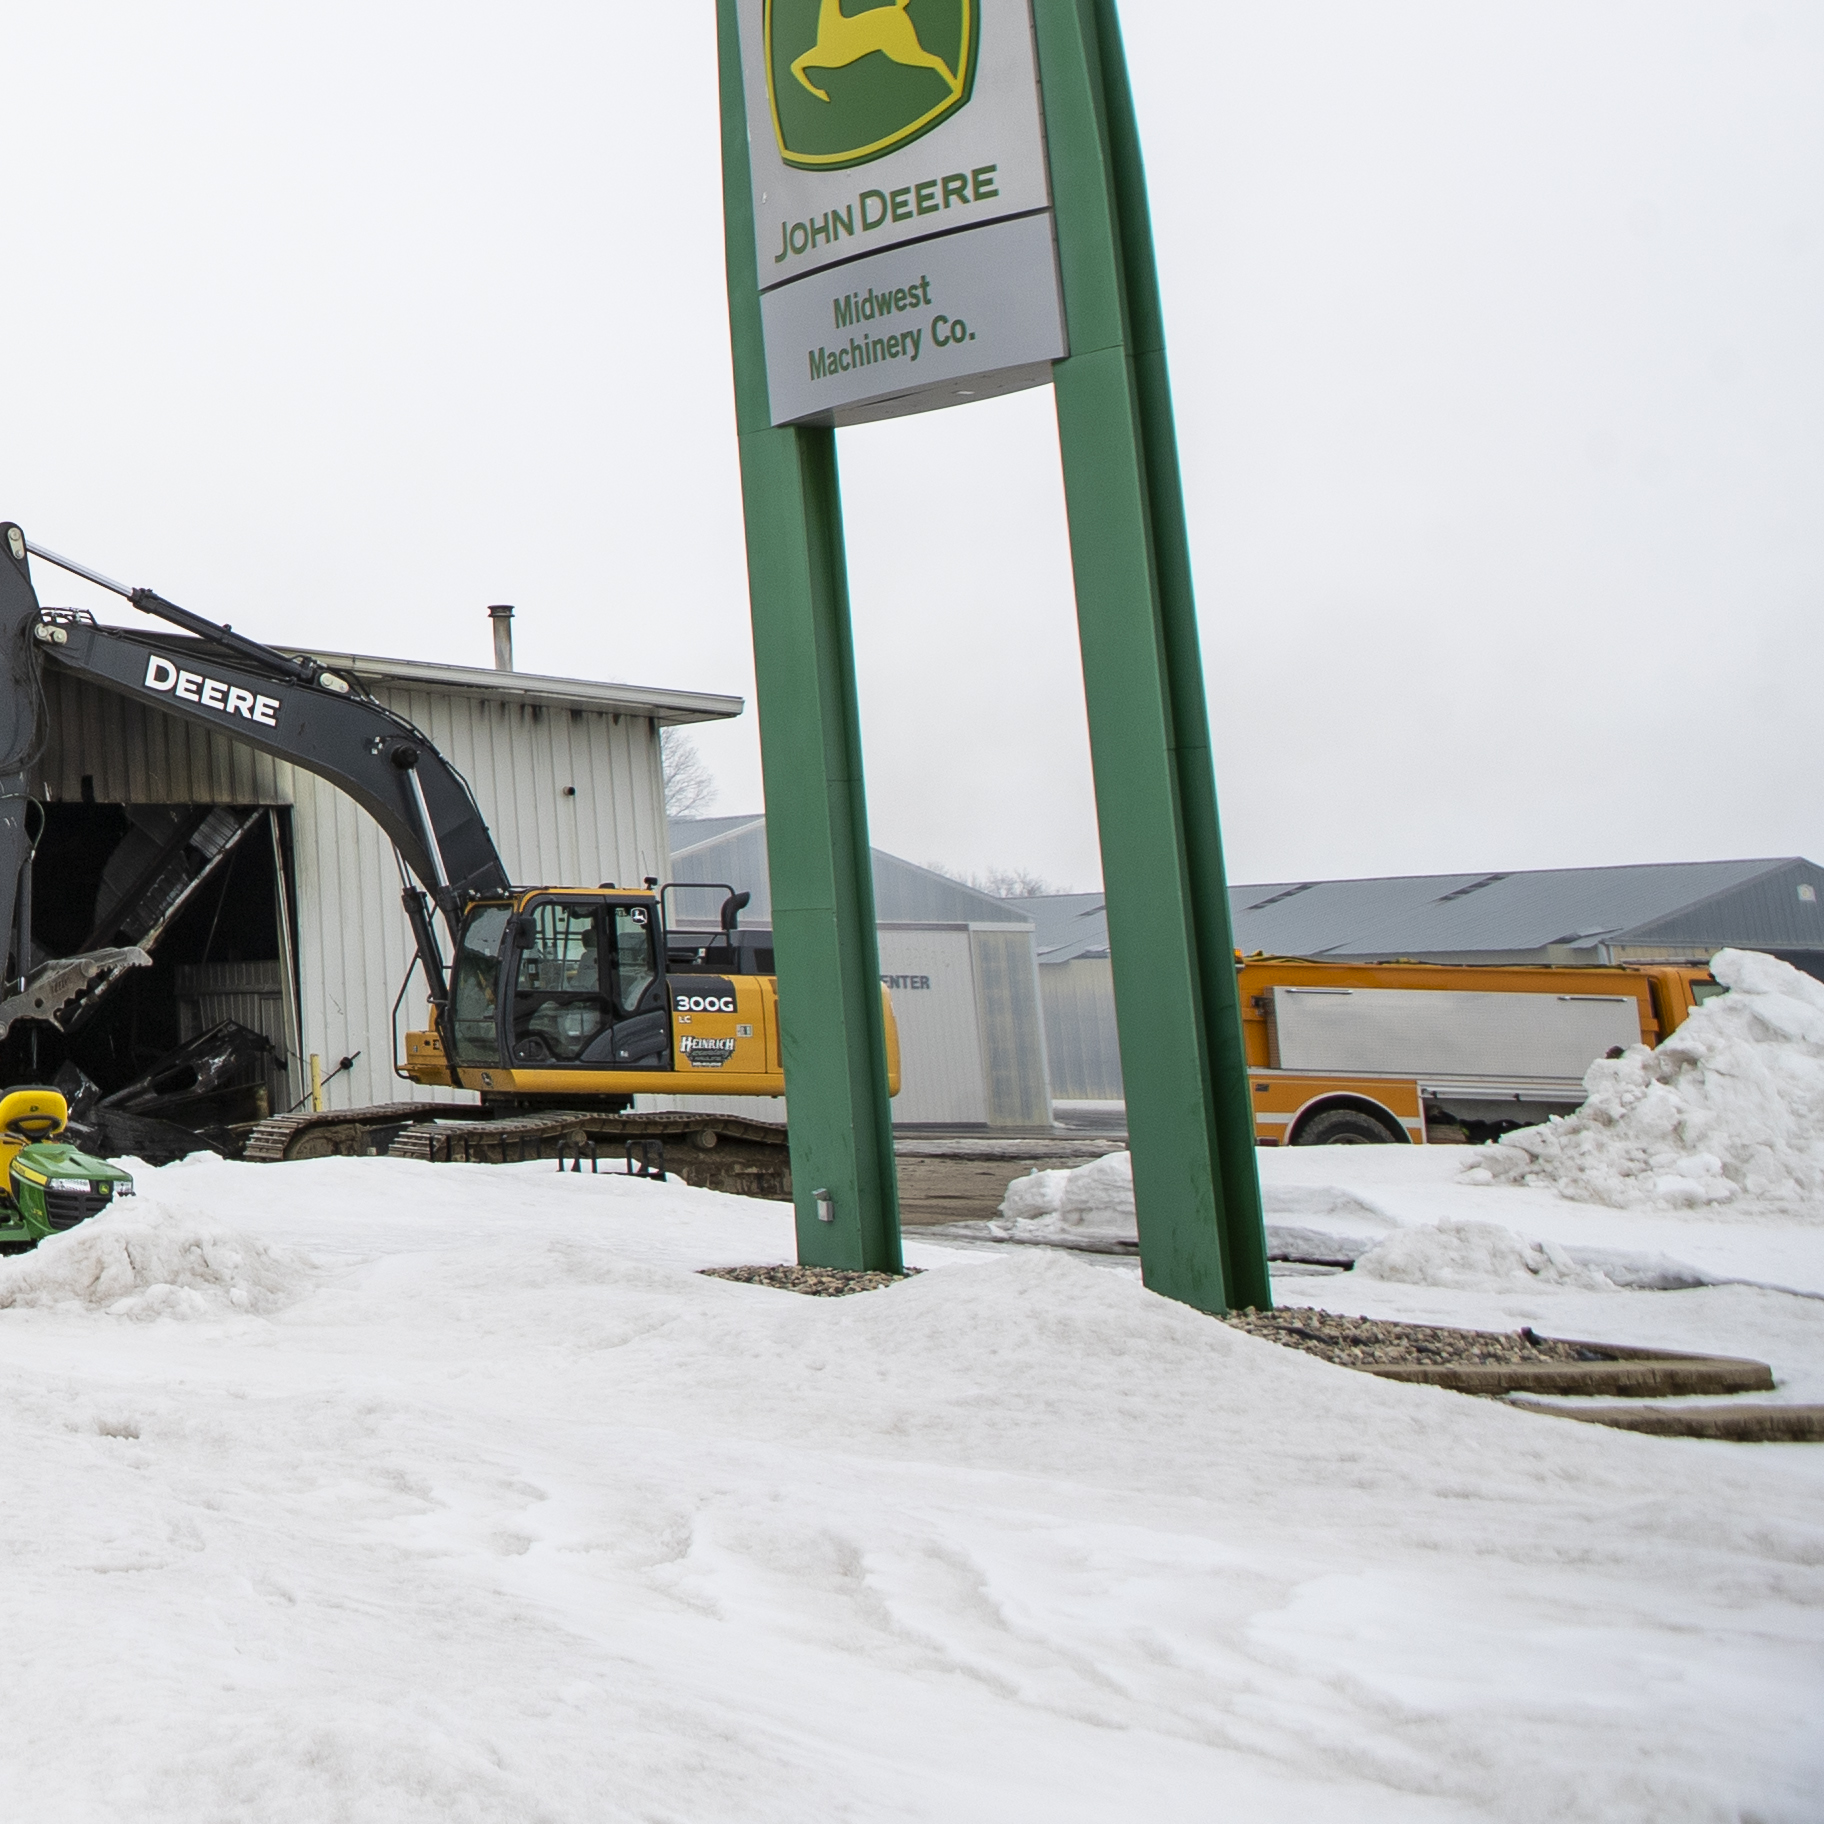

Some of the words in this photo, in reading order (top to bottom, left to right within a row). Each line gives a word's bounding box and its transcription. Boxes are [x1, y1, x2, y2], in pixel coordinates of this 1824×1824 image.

[774, 204, 855, 264] JOHN
[859, 164, 999, 232] DEERE
[833, 275, 932, 329] Midwest
[808, 328, 922, 381] Machinery
[931, 314, 976, 348] Co.
[144, 654, 280, 727] DEERE
[676, 995, 734, 1012] 300G
[680, 1036, 735, 1052] HEINRICH
